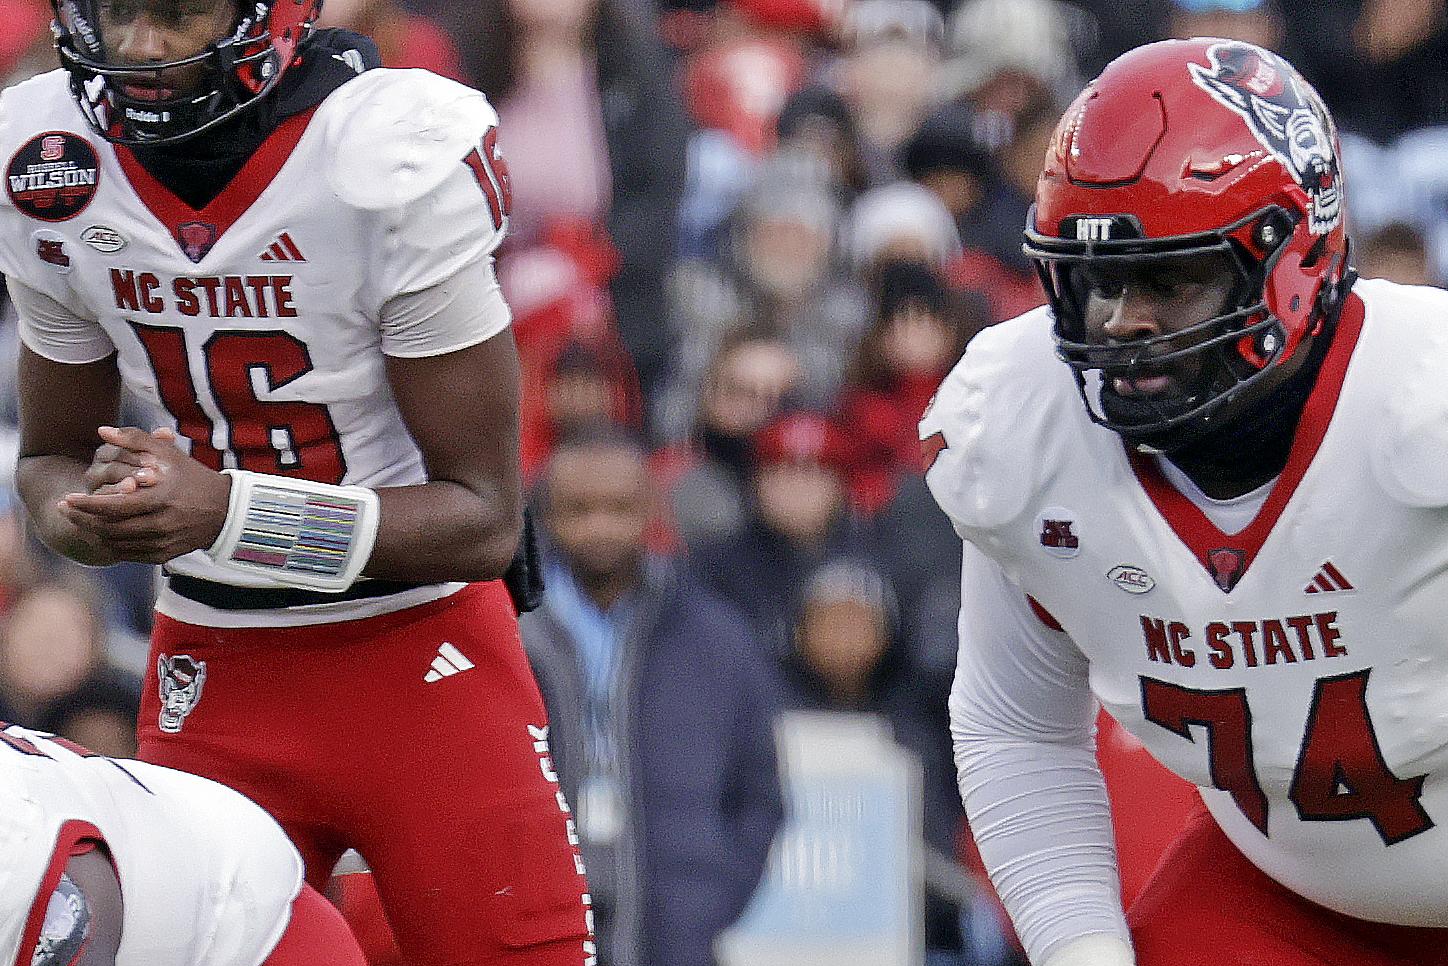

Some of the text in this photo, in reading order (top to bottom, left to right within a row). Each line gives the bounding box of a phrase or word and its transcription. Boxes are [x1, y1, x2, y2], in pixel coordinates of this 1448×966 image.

[9, 168, 97, 193] WILSON
[1076, 218, 1112, 241] HTT
[110, 268, 298, 318] NC STATE
[126, 319, 348, 486] 16
[1140, 611, 1348, 669] NC STATE
[1139, 668, 1436, 847] 74
